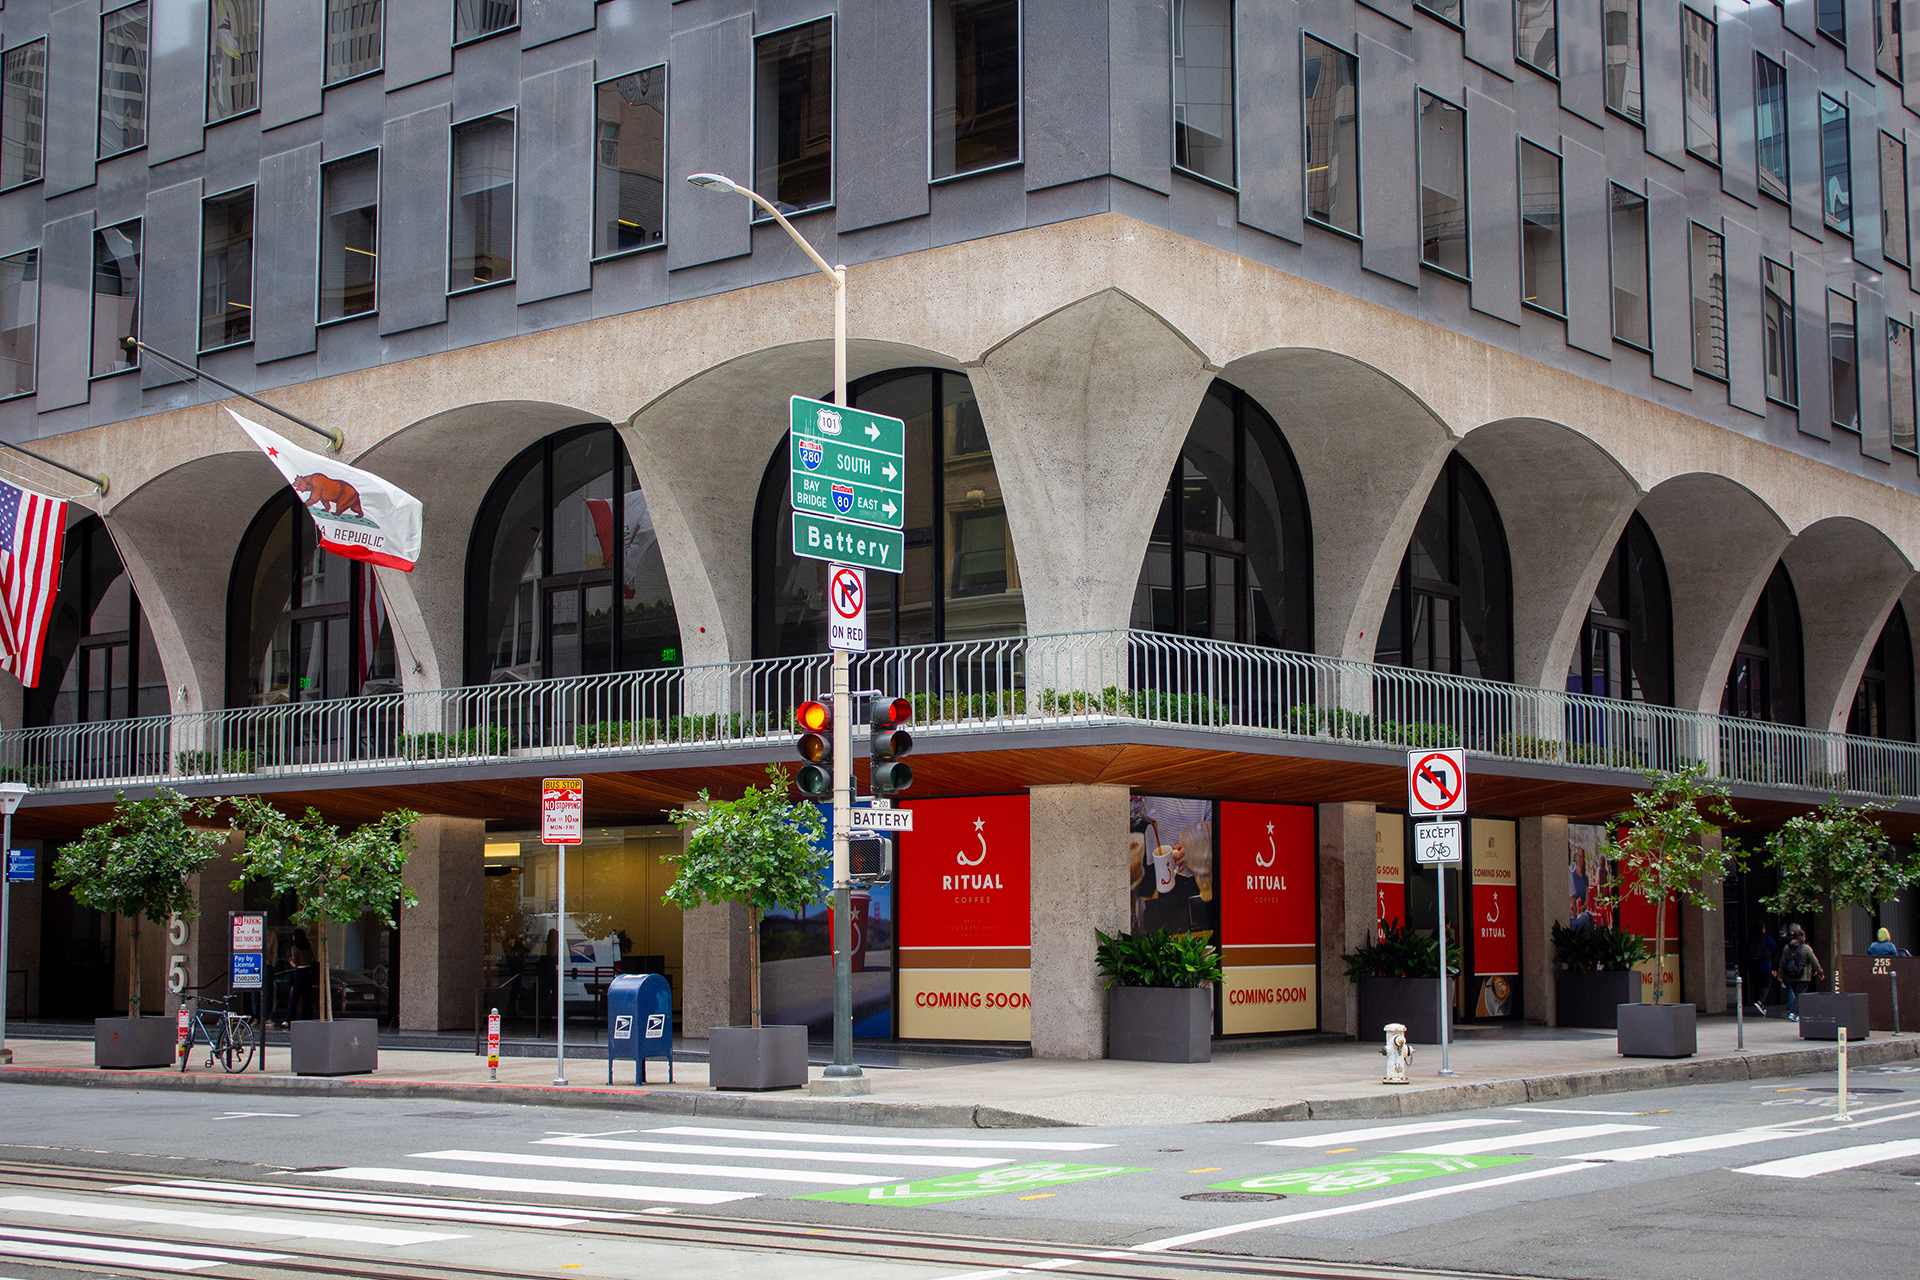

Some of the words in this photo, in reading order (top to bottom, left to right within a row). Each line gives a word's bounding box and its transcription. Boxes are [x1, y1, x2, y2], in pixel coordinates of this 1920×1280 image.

[822, 416, 836, 429] 101
[802, 450, 820, 464] 280
[837, 453, 870, 475] SOUTH
[803, 479, 820, 492] BAY
[797, 492, 827, 508] BRIDGE
[837, 496, 849, 509] 80
[858, 497, 878, 511] EAST
[333, 528, 385, 548] REPUBLIC
[808, 525, 889, 564] Battery
[832, 624, 844, 639] ON
[847, 626, 863, 641] RED
[545, 781, 560, 789] BUS
[561, 781, 580, 789] STOP
[544, 800, 555, 810] NO
[879, 800, 888, 808] 200
[853, 811, 909, 827] BATTERY
[1419, 827, 1456, 839] EXCEPT
[1382, 866, 1400, 876] SOON
[1473, 868, 1495, 878] COMING
[1496, 868, 1511, 878] SOON
[943, 873, 1003, 890] RITUAL
[1246, 875, 1287, 891] RITUAL
[954, 896, 991, 904] COFFEE
[1254, 896, 1279, 904] COFFEE
[1481, 928, 1506, 938] RITUAL
[234, 955, 245, 963] Pay
[246, 955, 254, 963] by
[1874, 958, 1891, 967] 255
[914, 991, 982, 1009] COMING
[985, 992, 1031, 1009] SOON
[1229, 988, 1274, 1006] COMING
[1275, 986, 1307, 1004] SOON
